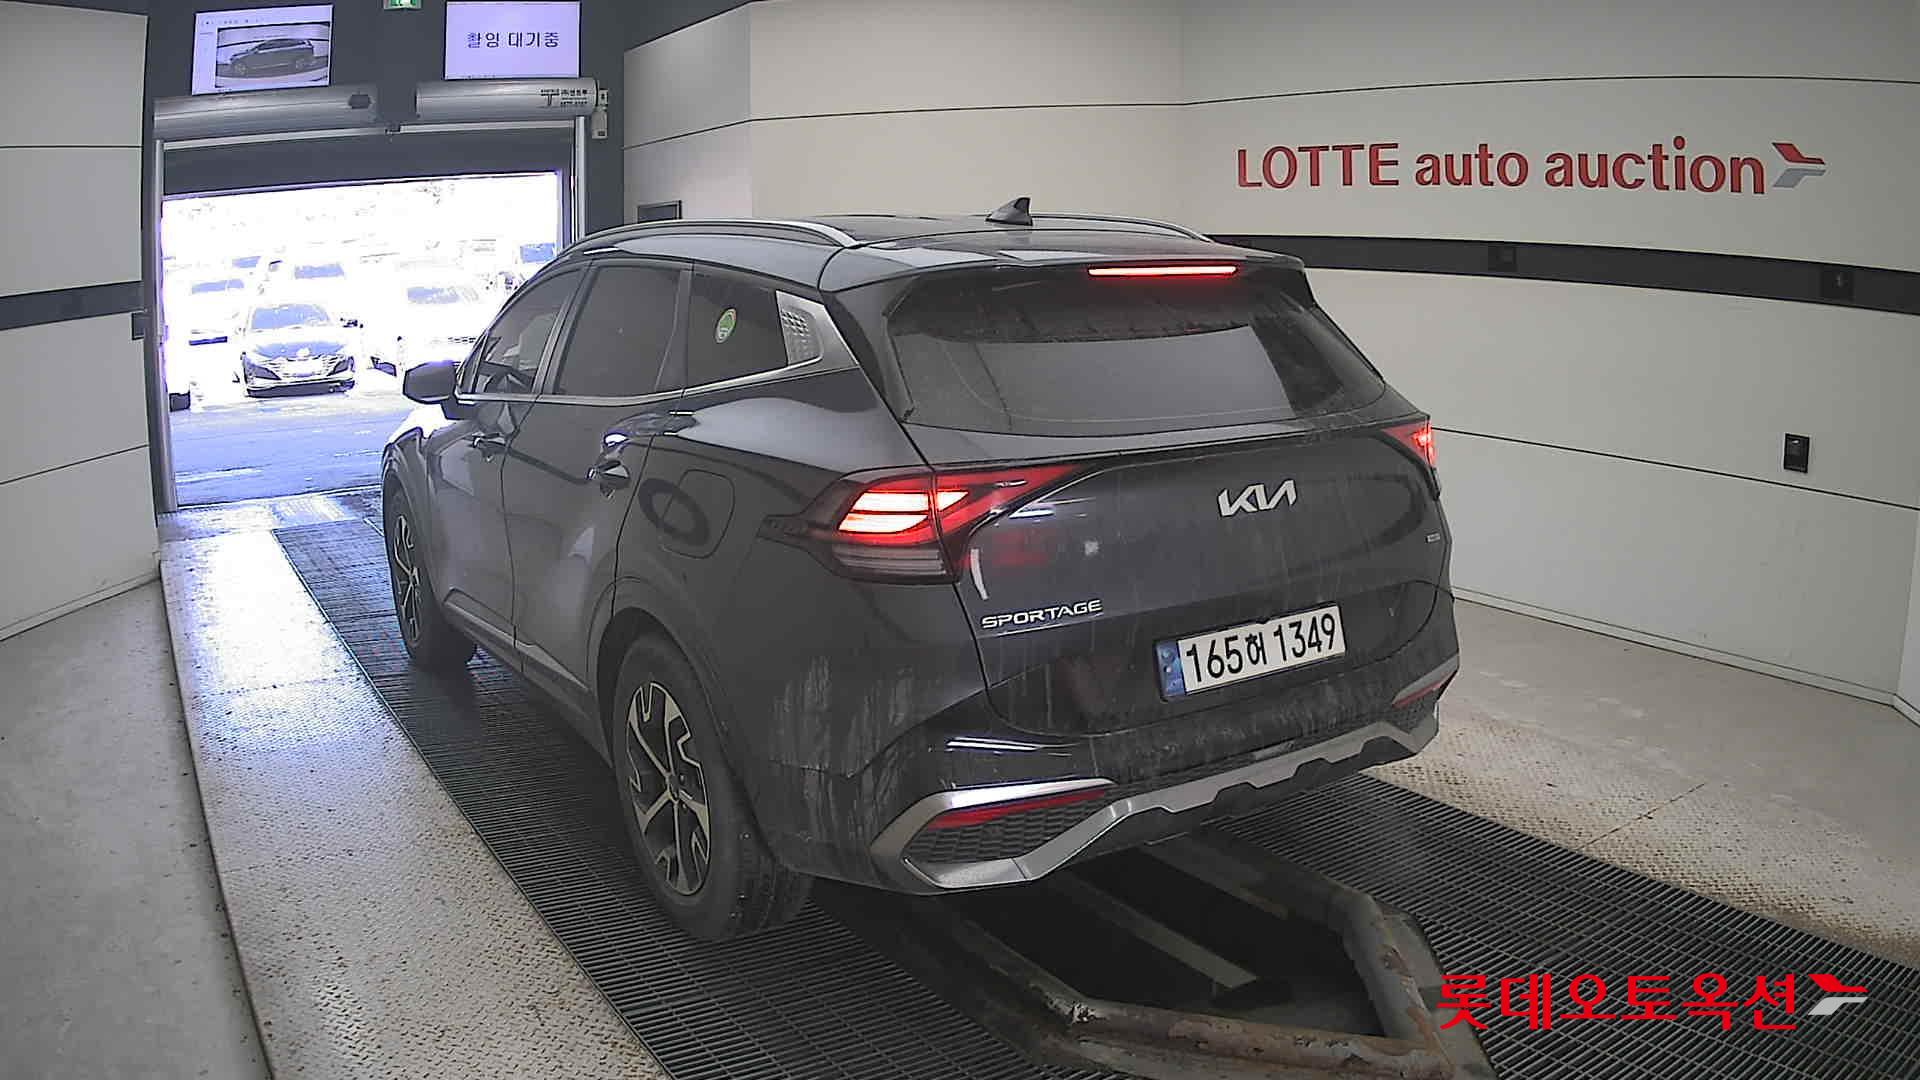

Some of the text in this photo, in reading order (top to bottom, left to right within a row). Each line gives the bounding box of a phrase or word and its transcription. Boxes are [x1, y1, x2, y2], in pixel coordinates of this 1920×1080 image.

[508, 31, 560, 48] 대기중
[1236, 136, 1765, 195] LOTTE auto auction
[1217, 480, 1298, 518] KIA
[980, 599, 1103, 630] SPORTAGE
